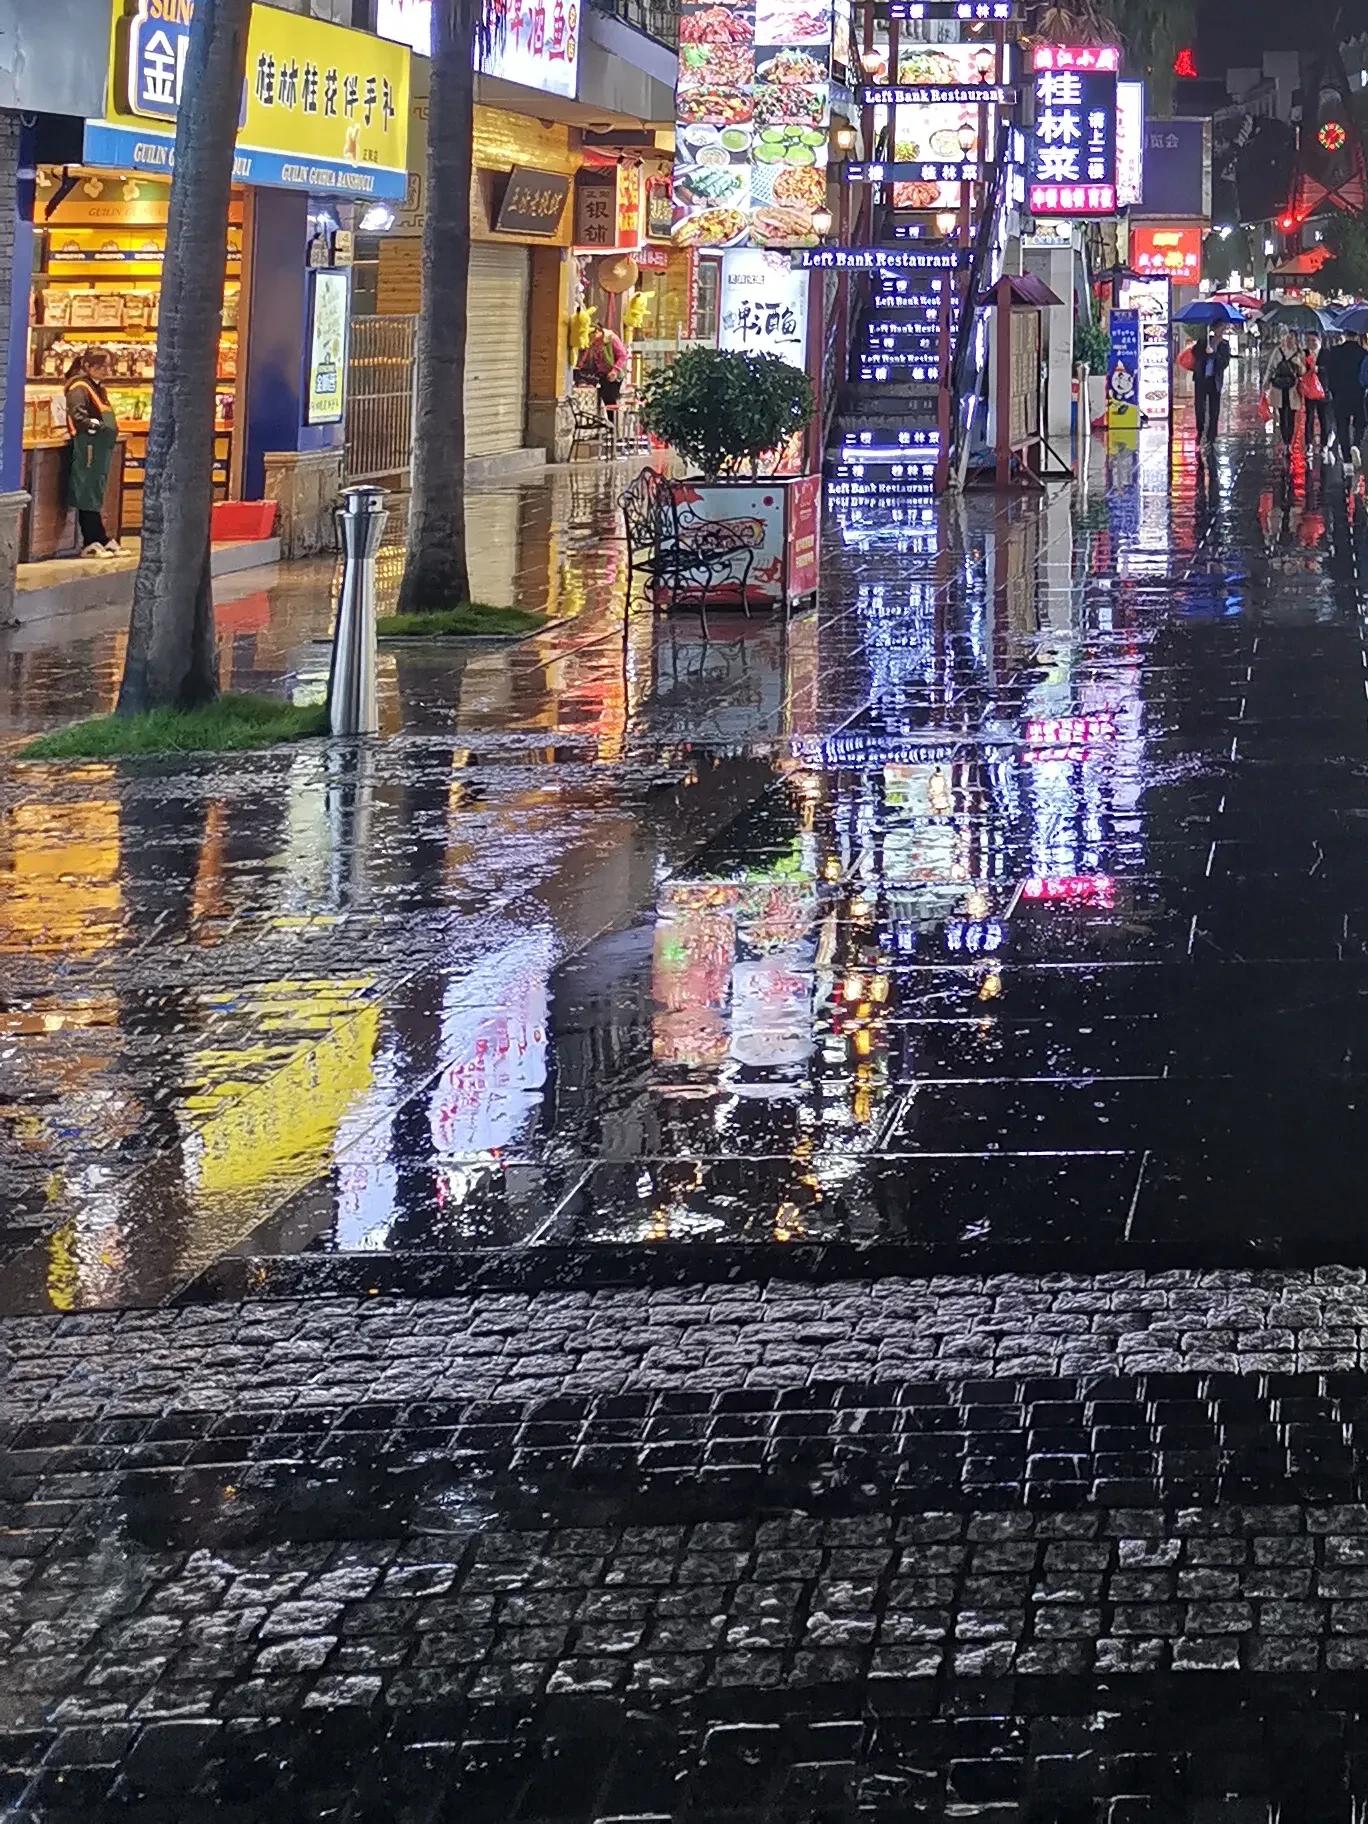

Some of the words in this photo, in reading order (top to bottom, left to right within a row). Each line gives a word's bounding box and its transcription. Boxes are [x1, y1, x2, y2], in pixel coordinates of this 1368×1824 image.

[256, 50, 396, 133] 桂林桂花伴手礼
[865, 90, 893, 103] Left
[895, 90, 929, 103] Bank
[931, 89, 1004, 103] Restaurant
[1036, 71, 1082, 182] 桂林菜
[281, 163, 308, 183] GUILIN
[583, 201, 609, 243] 银铺
[803, 253, 833, 267] Left
[836, 253, 874, 267] Bank
[875, 252, 958, 267] Restaurant
[828, 483, 849, 495] Left
[851, 483, 877, 494] Bank
